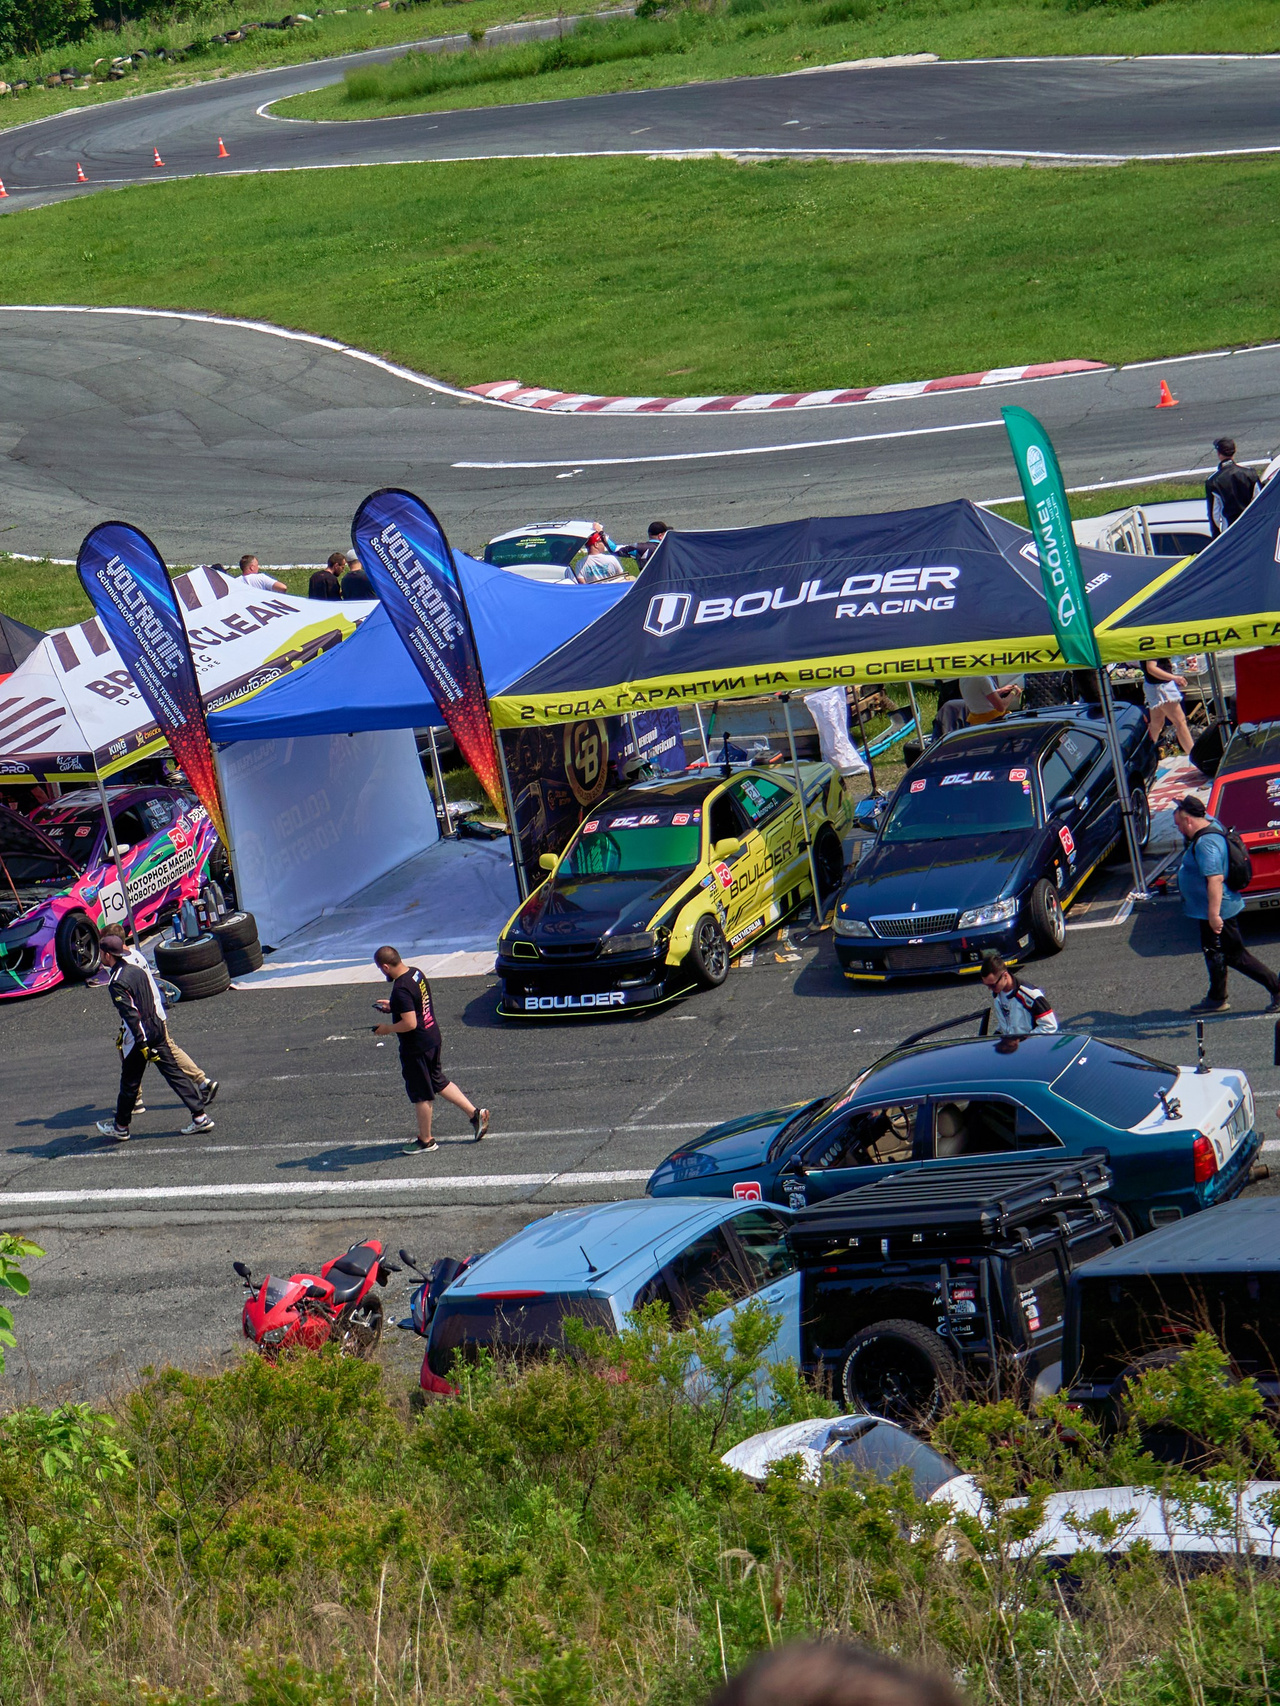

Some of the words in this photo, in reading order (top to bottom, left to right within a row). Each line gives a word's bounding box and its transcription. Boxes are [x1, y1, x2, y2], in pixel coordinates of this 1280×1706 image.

[1036, 500, 1066, 587] DOWEI
[370, 536, 412, 597] Schmierstoffe
[409, 595, 447, 650] Deutschland
[381, 523, 464, 642] VOLTRONIC
[693, 566, 961, 625] BOULDER
[835, 595, 957, 619] RACING
[96, 569, 136, 627] Schmierstoffe
[133, 626, 169, 678] Deutschland
[106, 555, 184, 671] VOLTRONIC
[1139, 637, 1156, 650] 2
[1166, 627, 1241, 648] ГОДА
[139, 655, 162, 690] НЕМЕЦКИЕ
[158, 684, 187, 725] ТЕХНОЛОГИИ
[207, 669, 280, 711] DREAMAUTO.PRO
[412, 636, 435, 671] КОНТРОЛЬ
[433, 669, 456, 703] КАЧЕСТВА
[415, 626, 438, 659] НЕМЕЦКИЕ
[435, 656, 464, 699] ТЕХНОЛОГИИ
[521, 705, 536, 720] 2
[543, 698, 607, 718] ГОДА
[617, 677, 748, 705] ГАРАНТИИ
[755, 669, 790, 686] НА
[799, 663, 856, 680] ВСЮ
[865, 648, 1062, 674] СПЕЦТЕХНИКУ
[138, 667, 159, 699] КОНТРОЛЬ
[158, 699, 179, 728] КАЧЕСТВА
[109, 741, 128, 755] KING
[748, 788, 758, 799] 21
[127, 865, 168, 894] МОТОРНОЕ
[168, 848, 193, 870] МАСЛО
[129, 883, 157, 904] НОВОГО
[157, 860, 195, 889] ПОКОЛЕНИЯ
[730, 840, 793, 899] BOULDER
[102, 891, 125, 918] FQ
[730, 918, 761, 946] POLYMERIUM
[524, 991, 626, 1010] BOULDER
[842, 1345, 860, 1387] COUNTRY
